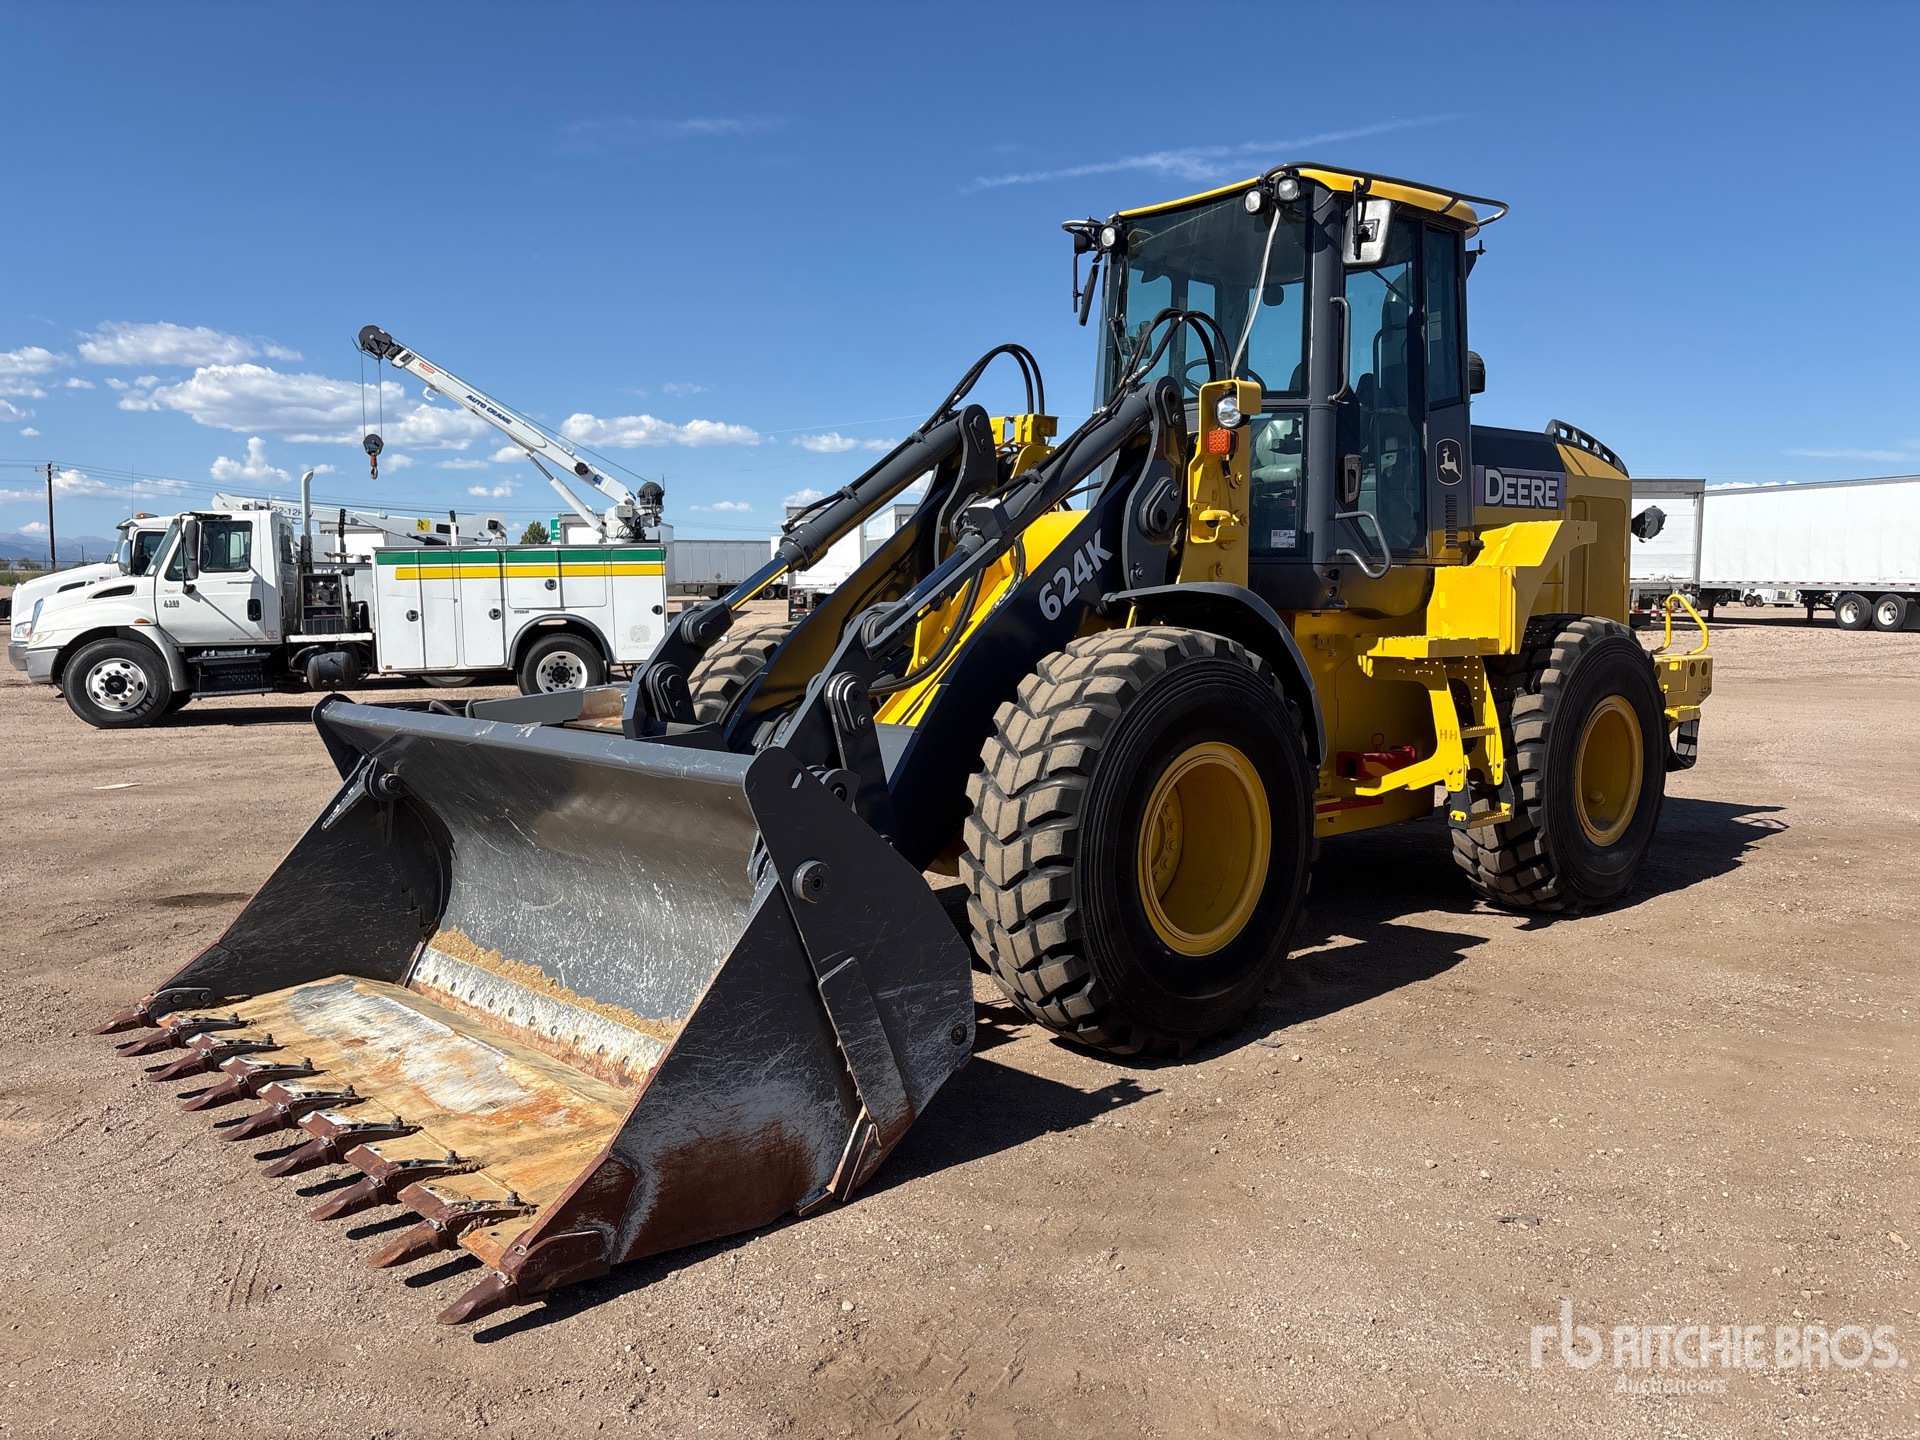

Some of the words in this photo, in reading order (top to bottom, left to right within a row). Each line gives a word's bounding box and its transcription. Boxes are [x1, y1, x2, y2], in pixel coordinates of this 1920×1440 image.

[466, 394, 487, 409] AUTO
[486, 407, 513, 425] CRANE
[1485, 468, 1558, 508] DEERE
[1038, 528, 1114, 621] 624K
